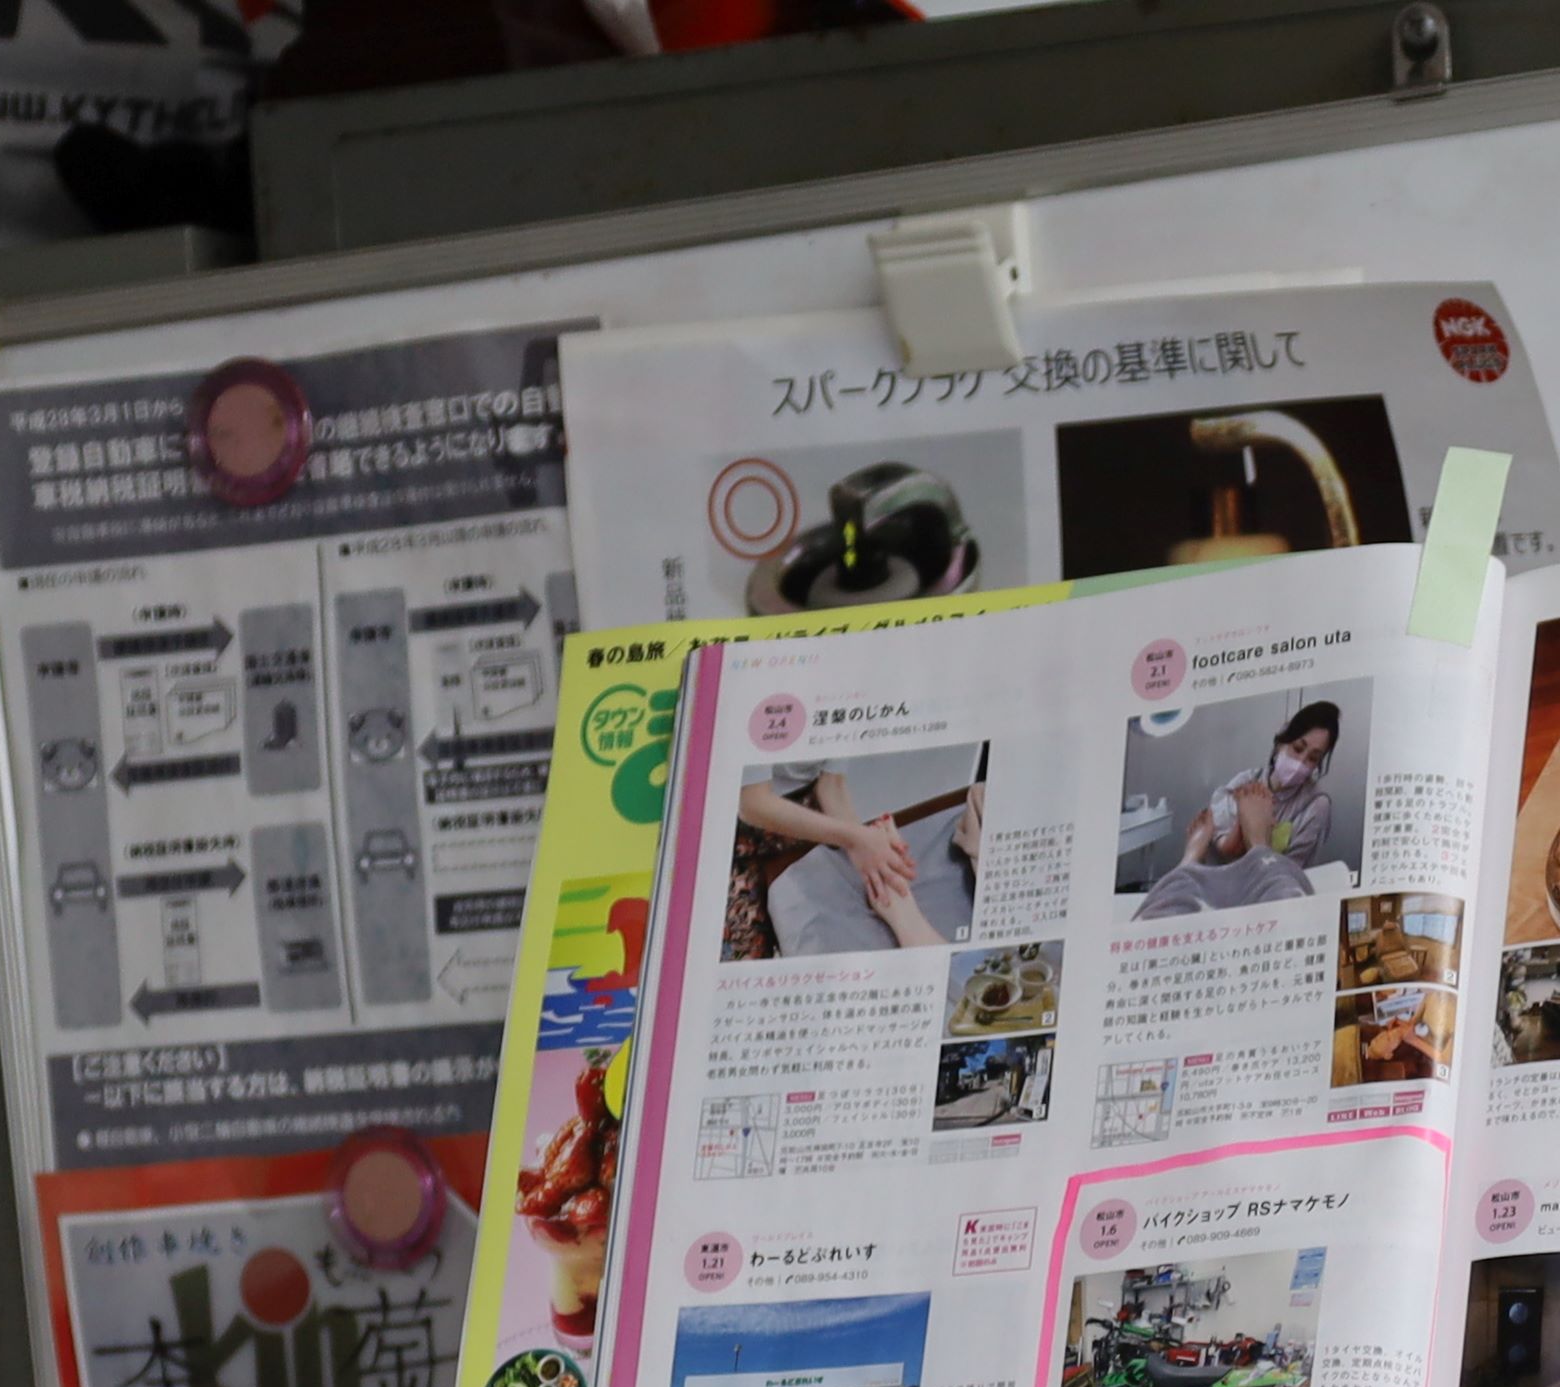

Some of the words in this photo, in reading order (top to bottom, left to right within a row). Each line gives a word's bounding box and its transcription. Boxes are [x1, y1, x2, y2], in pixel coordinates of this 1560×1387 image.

[1439, 314, 1495, 340] NGK
[585, 641, 666, 669] 春の島旅
[1192, 643, 1264, 671] footcare
[1270, 633, 1318, 658] salon
[1324, 628, 1352, 646] uta
[590, 708, 644, 727] タウン
[597, 728, 634, 750] 情報
[1096, 1210, 1125, 1223] 松山市
[1142, 1201, 1241, 1229] バイクショップ
[1247, 1192, 1350, 1218] RSナマケモノ
[1491, 1205, 1517, 1220] 1.23
[1100, 1224, 1117, 1237] 1.6
[701, 1256, 725, 1270] 1.21
